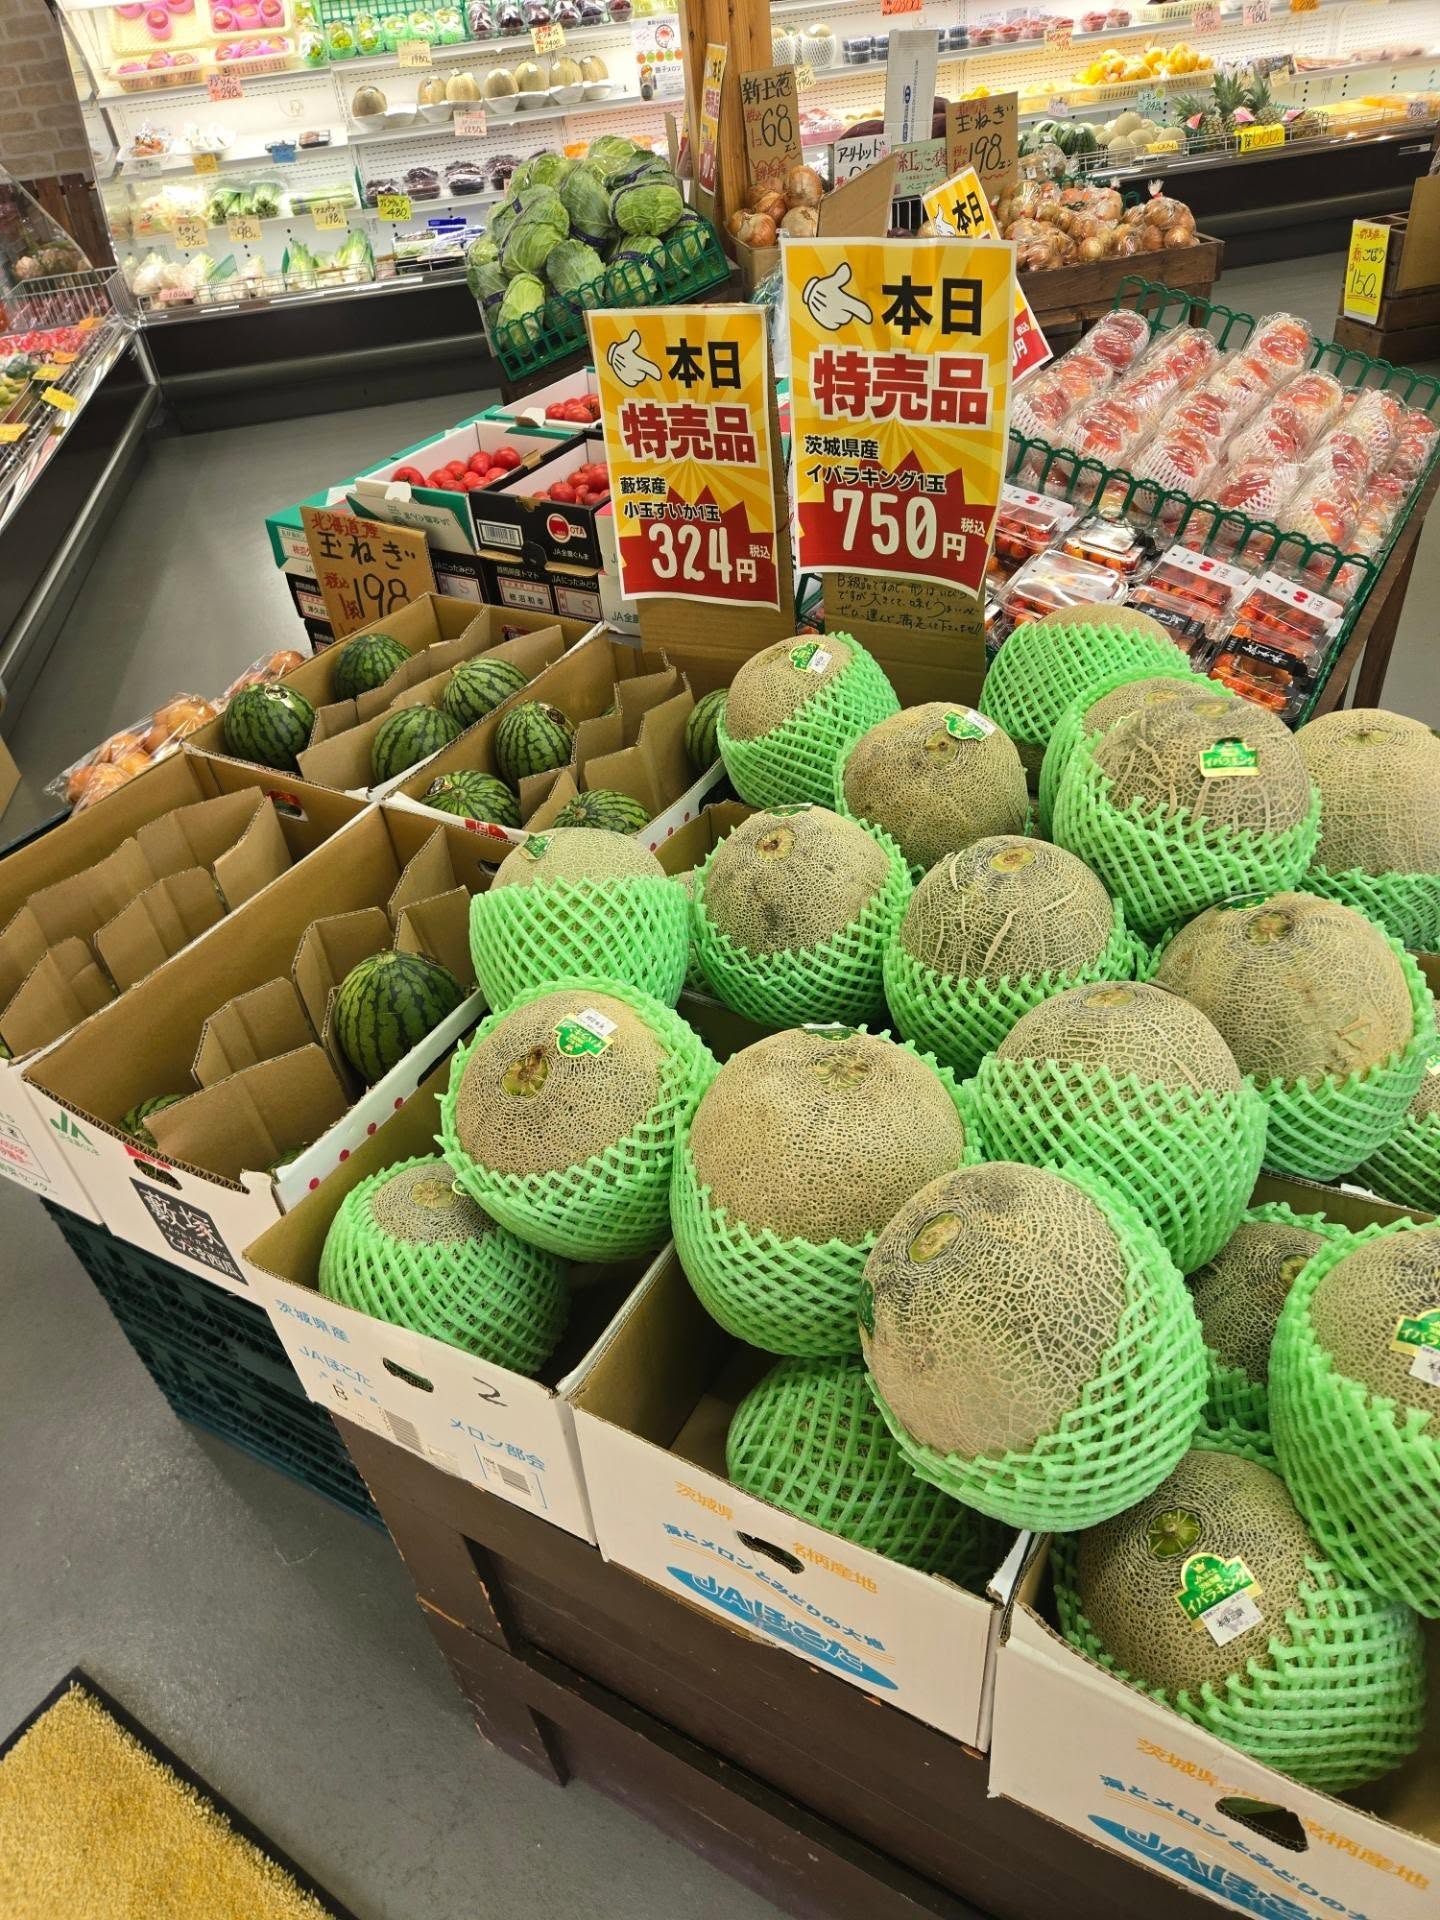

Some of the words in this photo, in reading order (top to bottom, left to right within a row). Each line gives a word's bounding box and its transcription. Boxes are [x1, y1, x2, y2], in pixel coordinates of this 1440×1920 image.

[951, 191, 984, 234] 本日
[880, 274, 983, 337] 本日
[665, 337, 742, 390] 本日
[813, 350, 989, 426] 特売品
[620, 402, 757, 464] 特売品
[804, 434, 880, 461] 茨城県産
[619, 475, 667, 496] 藪塚産
[805, 461, 947, 495] イバラキング1玉
[310, 511, 381, 540] 北海道産
[623, 500, 721, 525] 小玉すいか1玉
[960, 517, 987, 538] 税込
[317, 531, 416, 571] 玉ねぎ
[748, 543, 771, 560] 税込
[472, 1375, 509, 1408] 2
[449, 1416, 547, 1472] メロン部会
